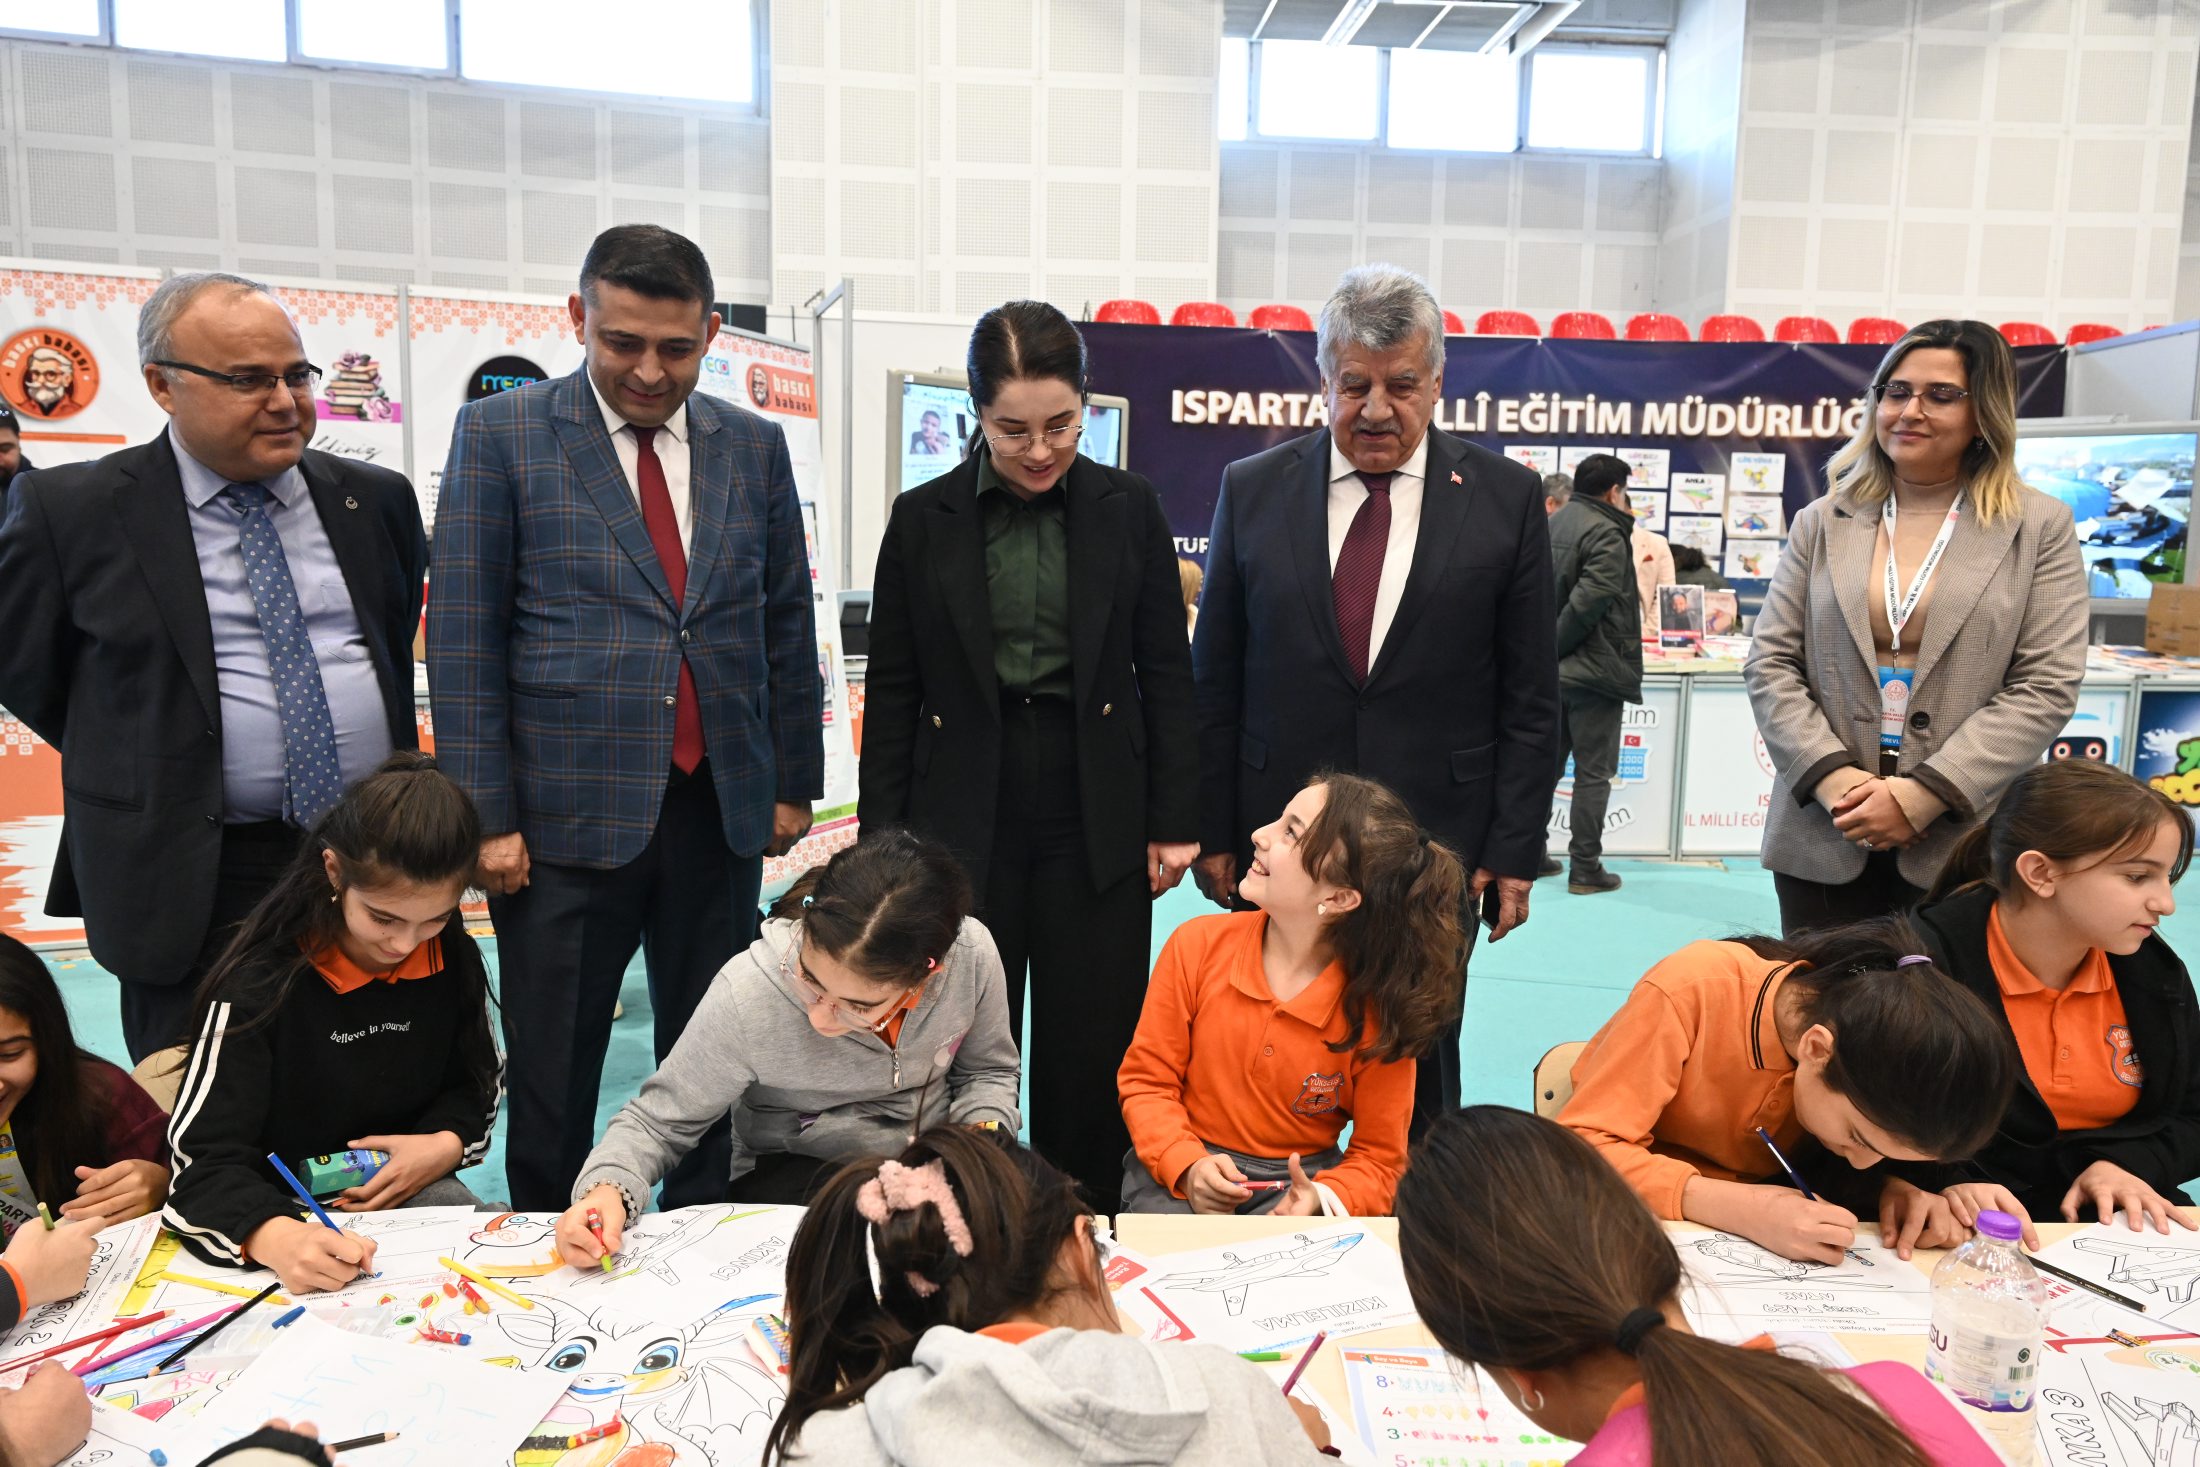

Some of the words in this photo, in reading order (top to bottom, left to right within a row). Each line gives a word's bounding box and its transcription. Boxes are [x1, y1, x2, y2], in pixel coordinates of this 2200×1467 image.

[1171, 389, 1328, 427] ISPARTA
[1498, 392, 1632, 435] EĞİTİM
[369, 1025, 378, 1034] in
[1376, 1375, 1389, 1388] 8
[1382, 1406, 1394, 1418] 4
[1386, 1428, 1400, 1440] 3
